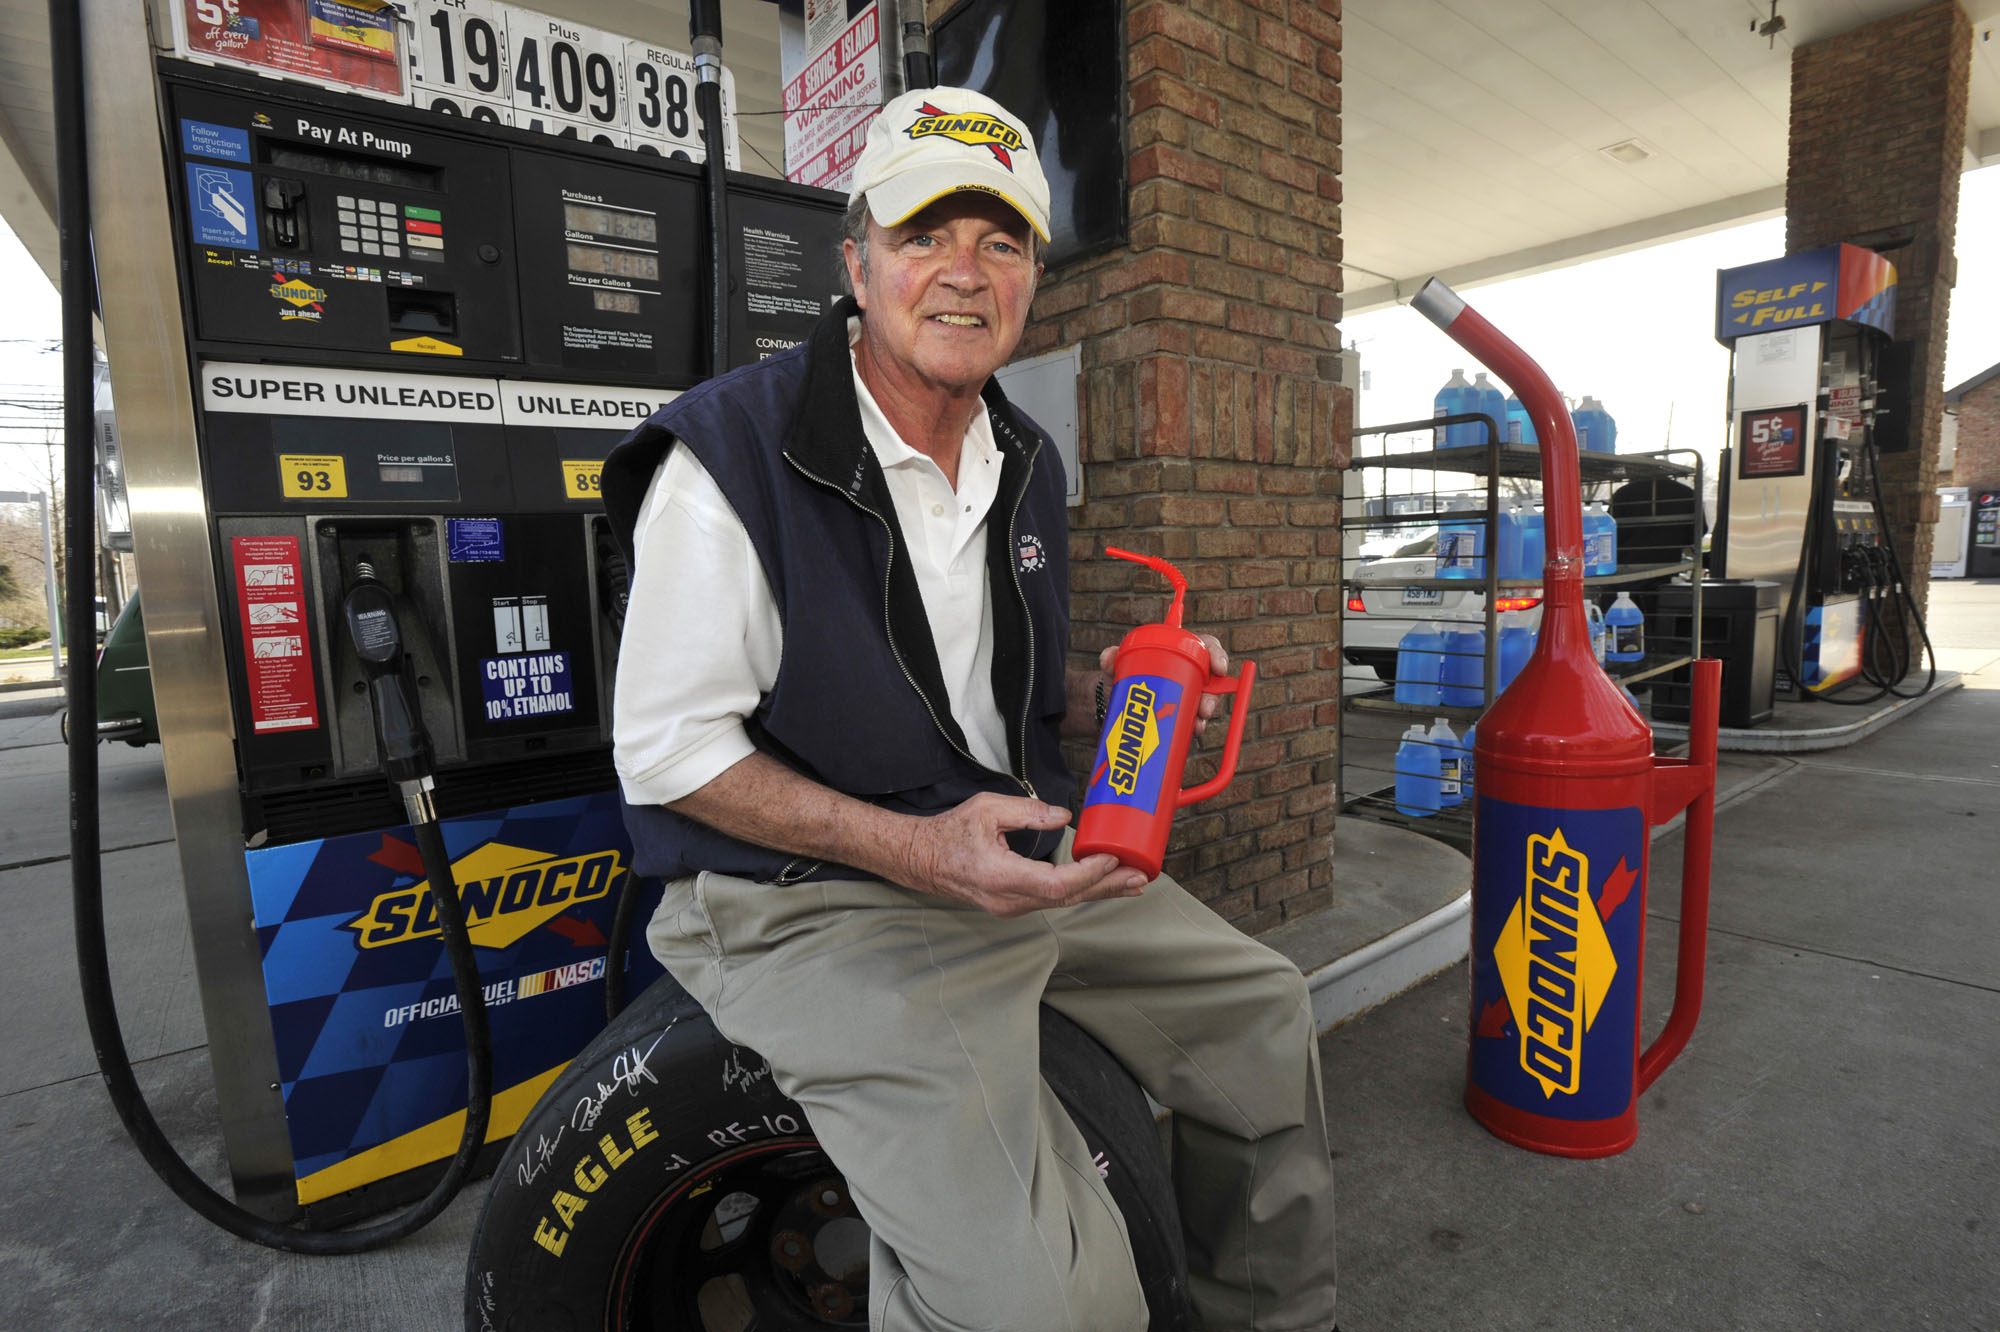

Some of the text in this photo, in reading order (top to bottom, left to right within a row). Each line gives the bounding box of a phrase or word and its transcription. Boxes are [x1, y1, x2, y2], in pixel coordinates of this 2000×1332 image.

[205, 26, 249, 44] off every
[549, 22, 580, 42] Plus
[804, 45, 837, 97] SERVICE
[841, 12, 875, 67] ISLAND
[515, 37, 616, 122] 4.09
[796, 63, 865, 132] WARNING
[191, 125, 219, 138] Follow
[297, 119, 412, 158] Pay At Pump
[915, 118, 1018, 147] SUNOCO
[192, 134, 242, 150] Instructions
[205, 144, 236, 157] Screen
[834, 132, 852, 165] STOP
[562, 189, 596, 202] Purchase
[955, 184, 1000, 196] SUNOCO
[202, 226, 235, 237] Insert and
[202, 233, 246, 245] Remove Card
[565, 230, 594, 241] Gallons
[743, 226, 790, 241] Health Warning
[207, 258, 233, 266] Accept
[568, 274, 587, 282] Price
[602, 278, 626, 287] Gallon
[271, 284, 325, 302] SUNOCO
[1731, 283, 1808, 308] SELF
[279, 308, 322, 319] Just ahead.
[1750, 303, 1825, 327] FULL
[212, 377, 495, 411] SUPER UNLEADED
[518, 395, 652, 418] UNLEADED
[1752, 416, 1783, 444] 5¢
[377, 454, 452, 464] Price per gallon $
[297, 471, 332, 491] 93
[576, 473, 601, 492] 89
[1021, 534, 1042, 549] OPEN
[357, 609, 387, 620] WARNING
[486, 654, 565, 680] CONTAINS
[503, 675, 552, 698] UP TO
[486, 692, 573, 720] 10% ETHANOL
[1111, 687, 1153, 791] SUNOCO
[1524, 840, 1582, 1089] SUNOCO
[384, 994, 462, 1028] OFFICIA
[481, 980, 516, 1002] UEL
[707, 1114, 800, 1148] RF-10
[532, 1107, 660, 1258] EAGLE
